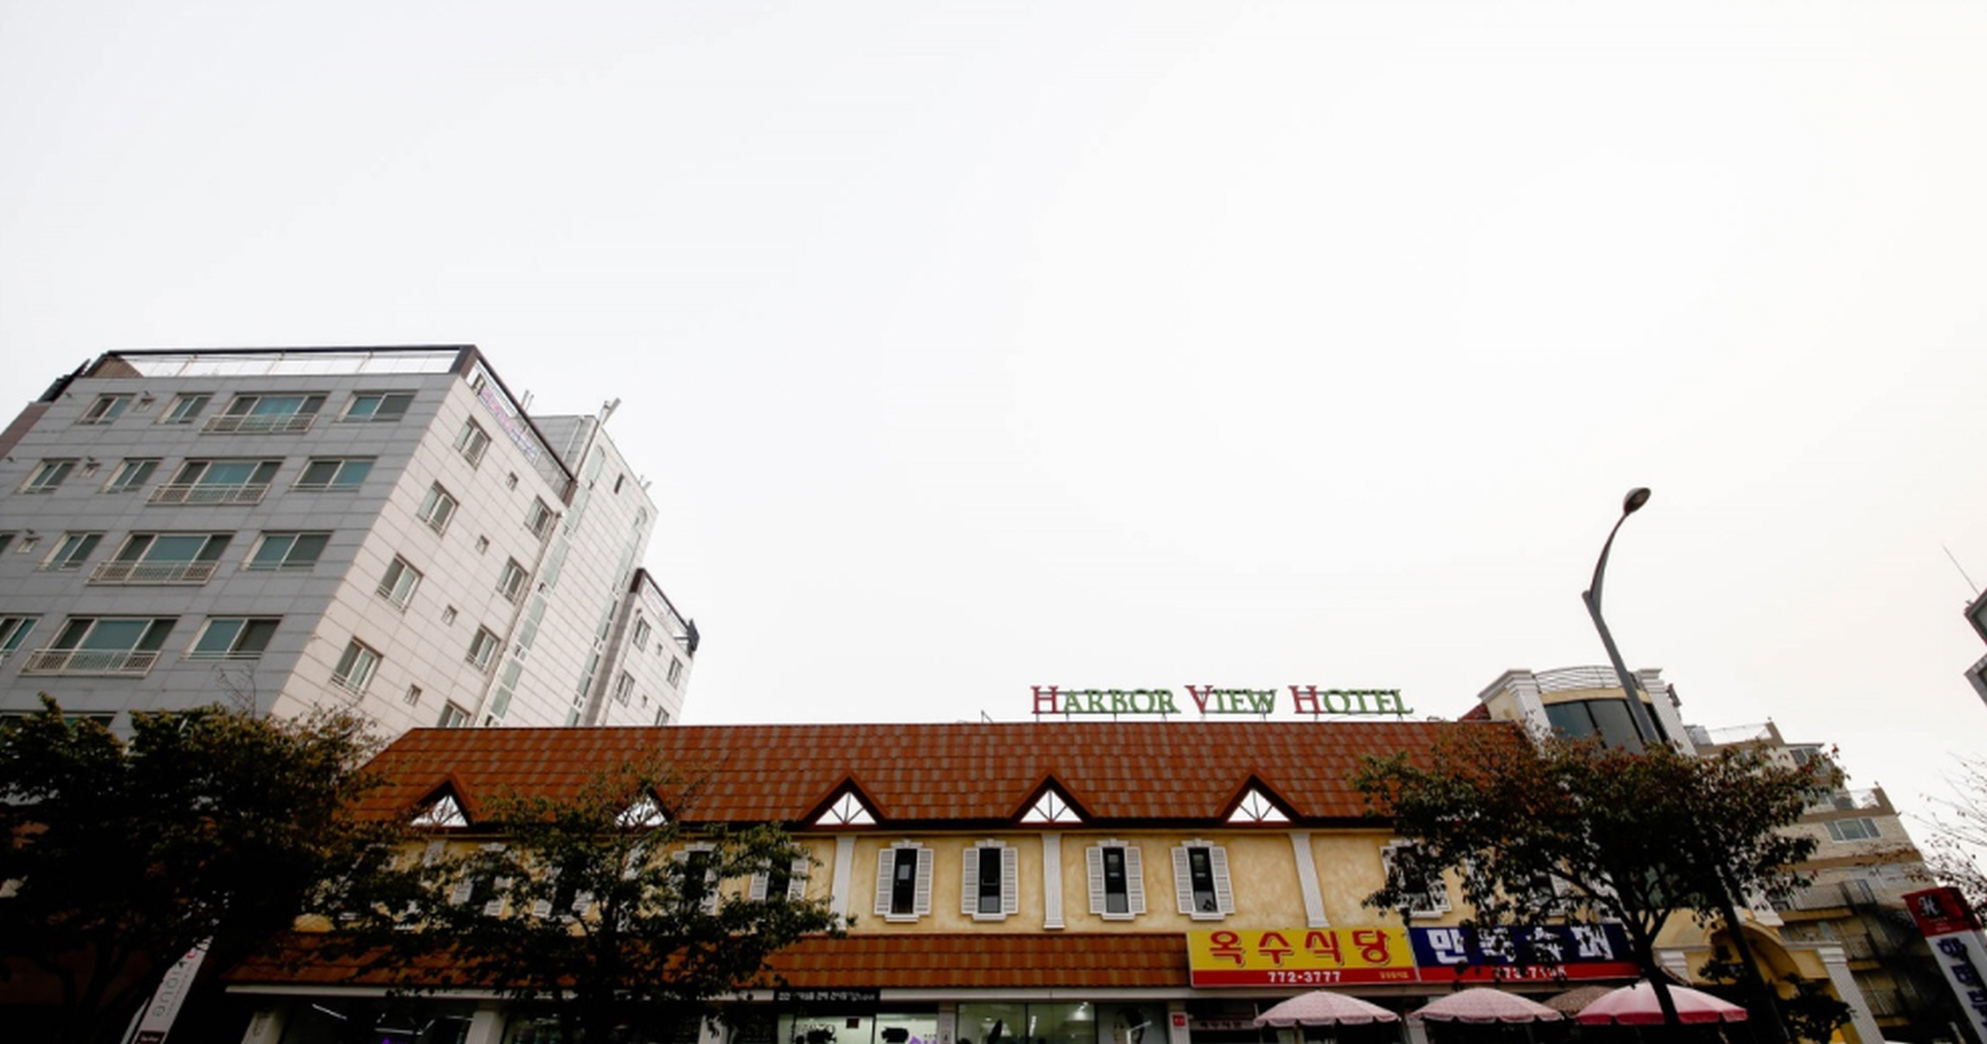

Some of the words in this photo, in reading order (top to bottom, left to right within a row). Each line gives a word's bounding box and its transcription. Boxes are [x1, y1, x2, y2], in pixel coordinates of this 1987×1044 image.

[1030, 685, 1181, 714] HARBOR
[1184, 685, 1277, 714] VIEW
[1288, 685, 1414, 714] HOTEL
[1209, 930, 1390, 966] 옥수식당
